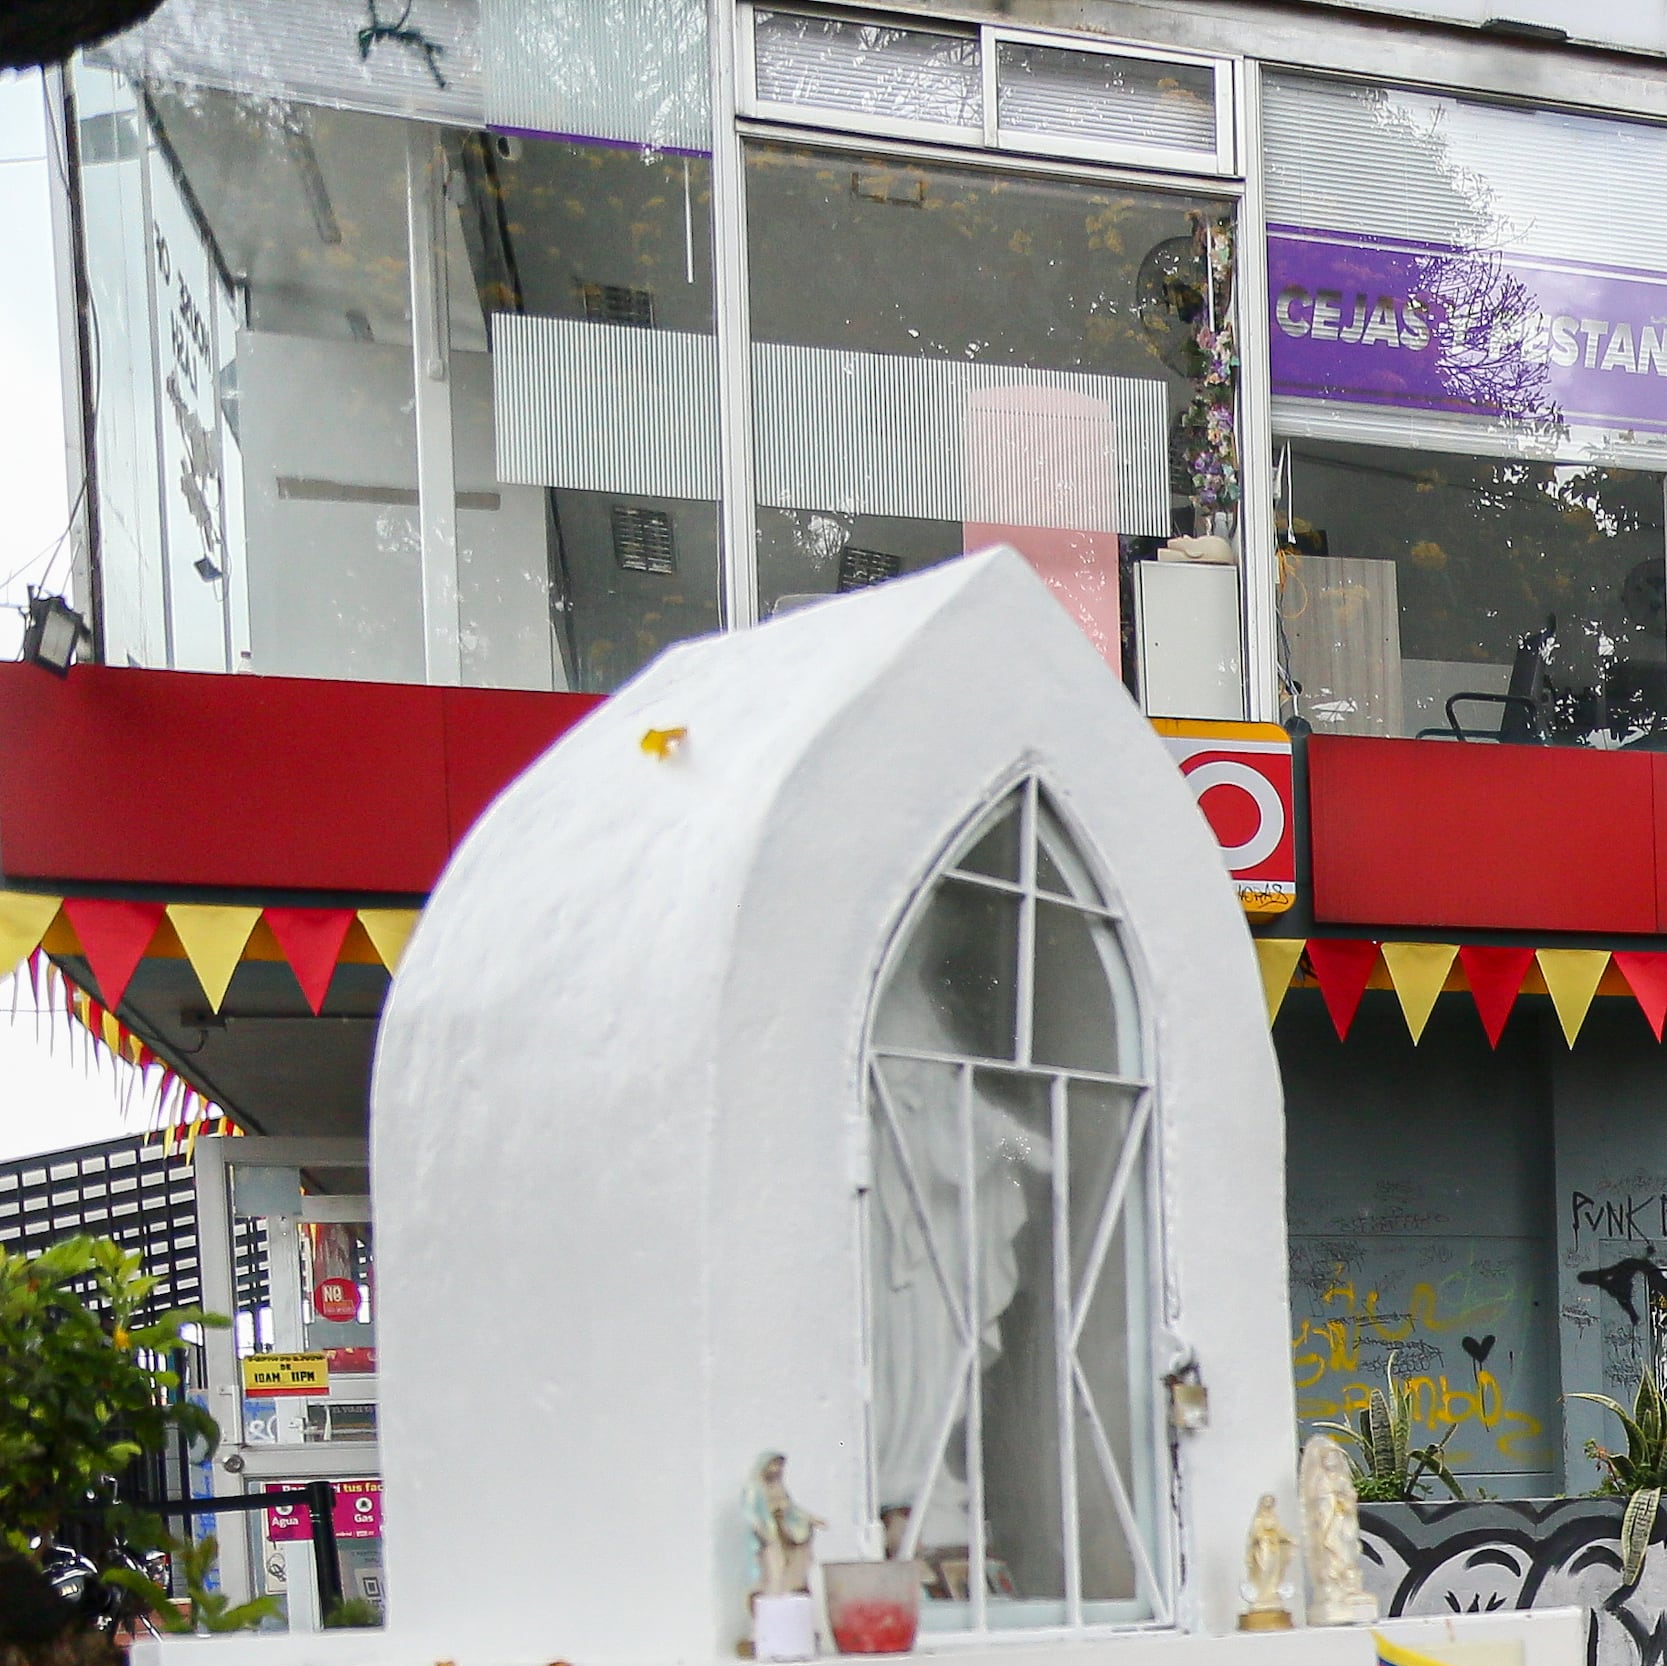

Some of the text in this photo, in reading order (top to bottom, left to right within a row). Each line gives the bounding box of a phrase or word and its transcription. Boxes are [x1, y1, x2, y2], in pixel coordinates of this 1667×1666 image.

[1274, 284, 1432, 352] CEJAS
[343, 1484, 362, 1493] tus
[271, 1513, 374, 1528] Agua Gas
